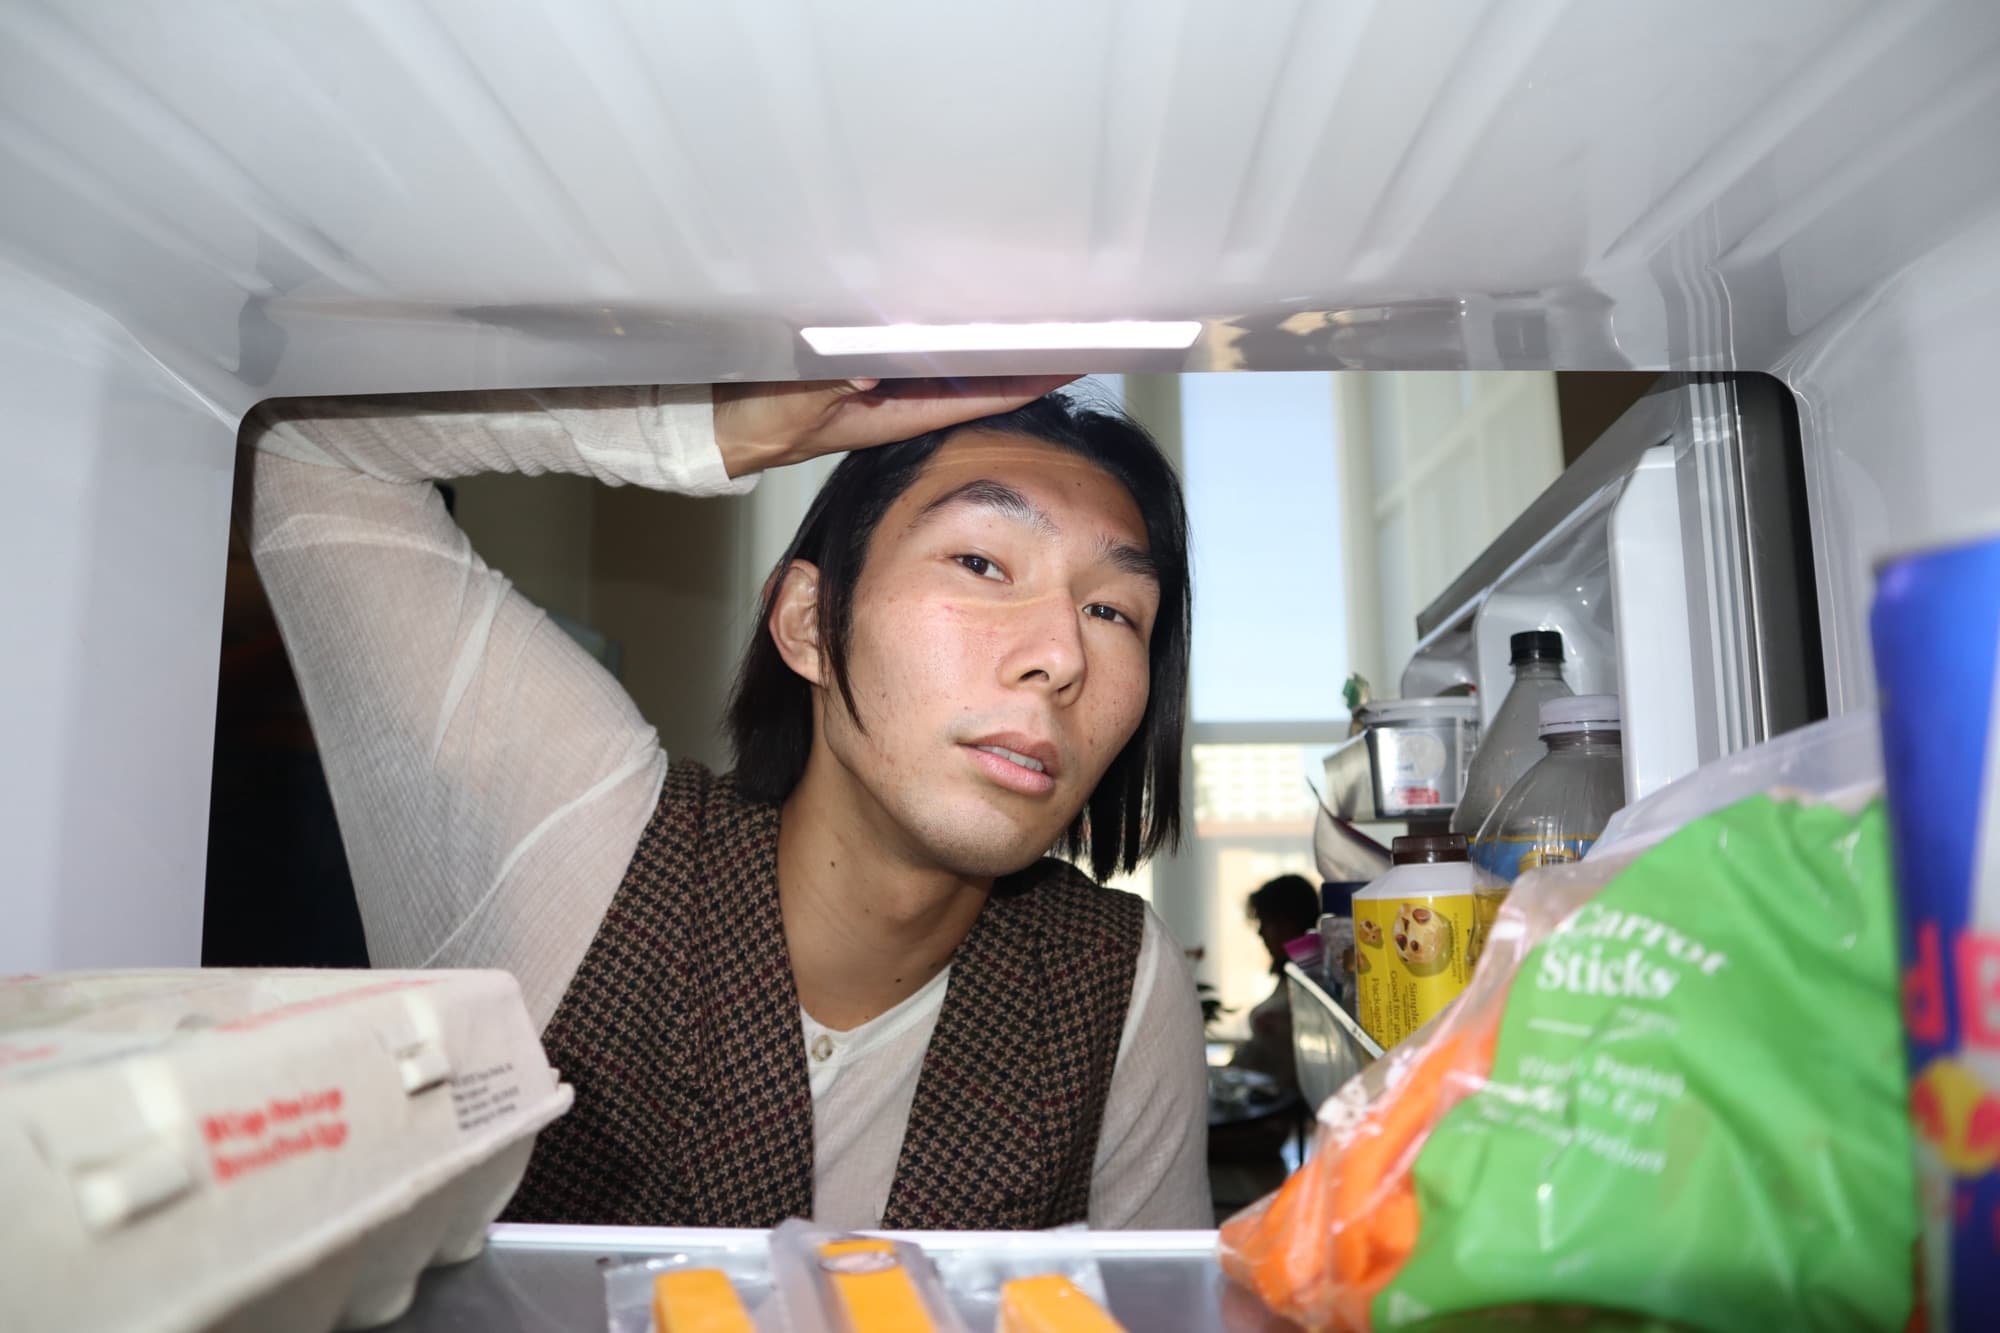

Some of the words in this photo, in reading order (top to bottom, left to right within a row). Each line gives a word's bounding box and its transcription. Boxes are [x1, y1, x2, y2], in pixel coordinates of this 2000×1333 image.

[1390, 970, 1400, 1002] Good
[1536, 945, 1677, 998] Sticks
[1371, 978, 1384, 1033] Packaged
[1409, 983, 1420, 1023] Simple
